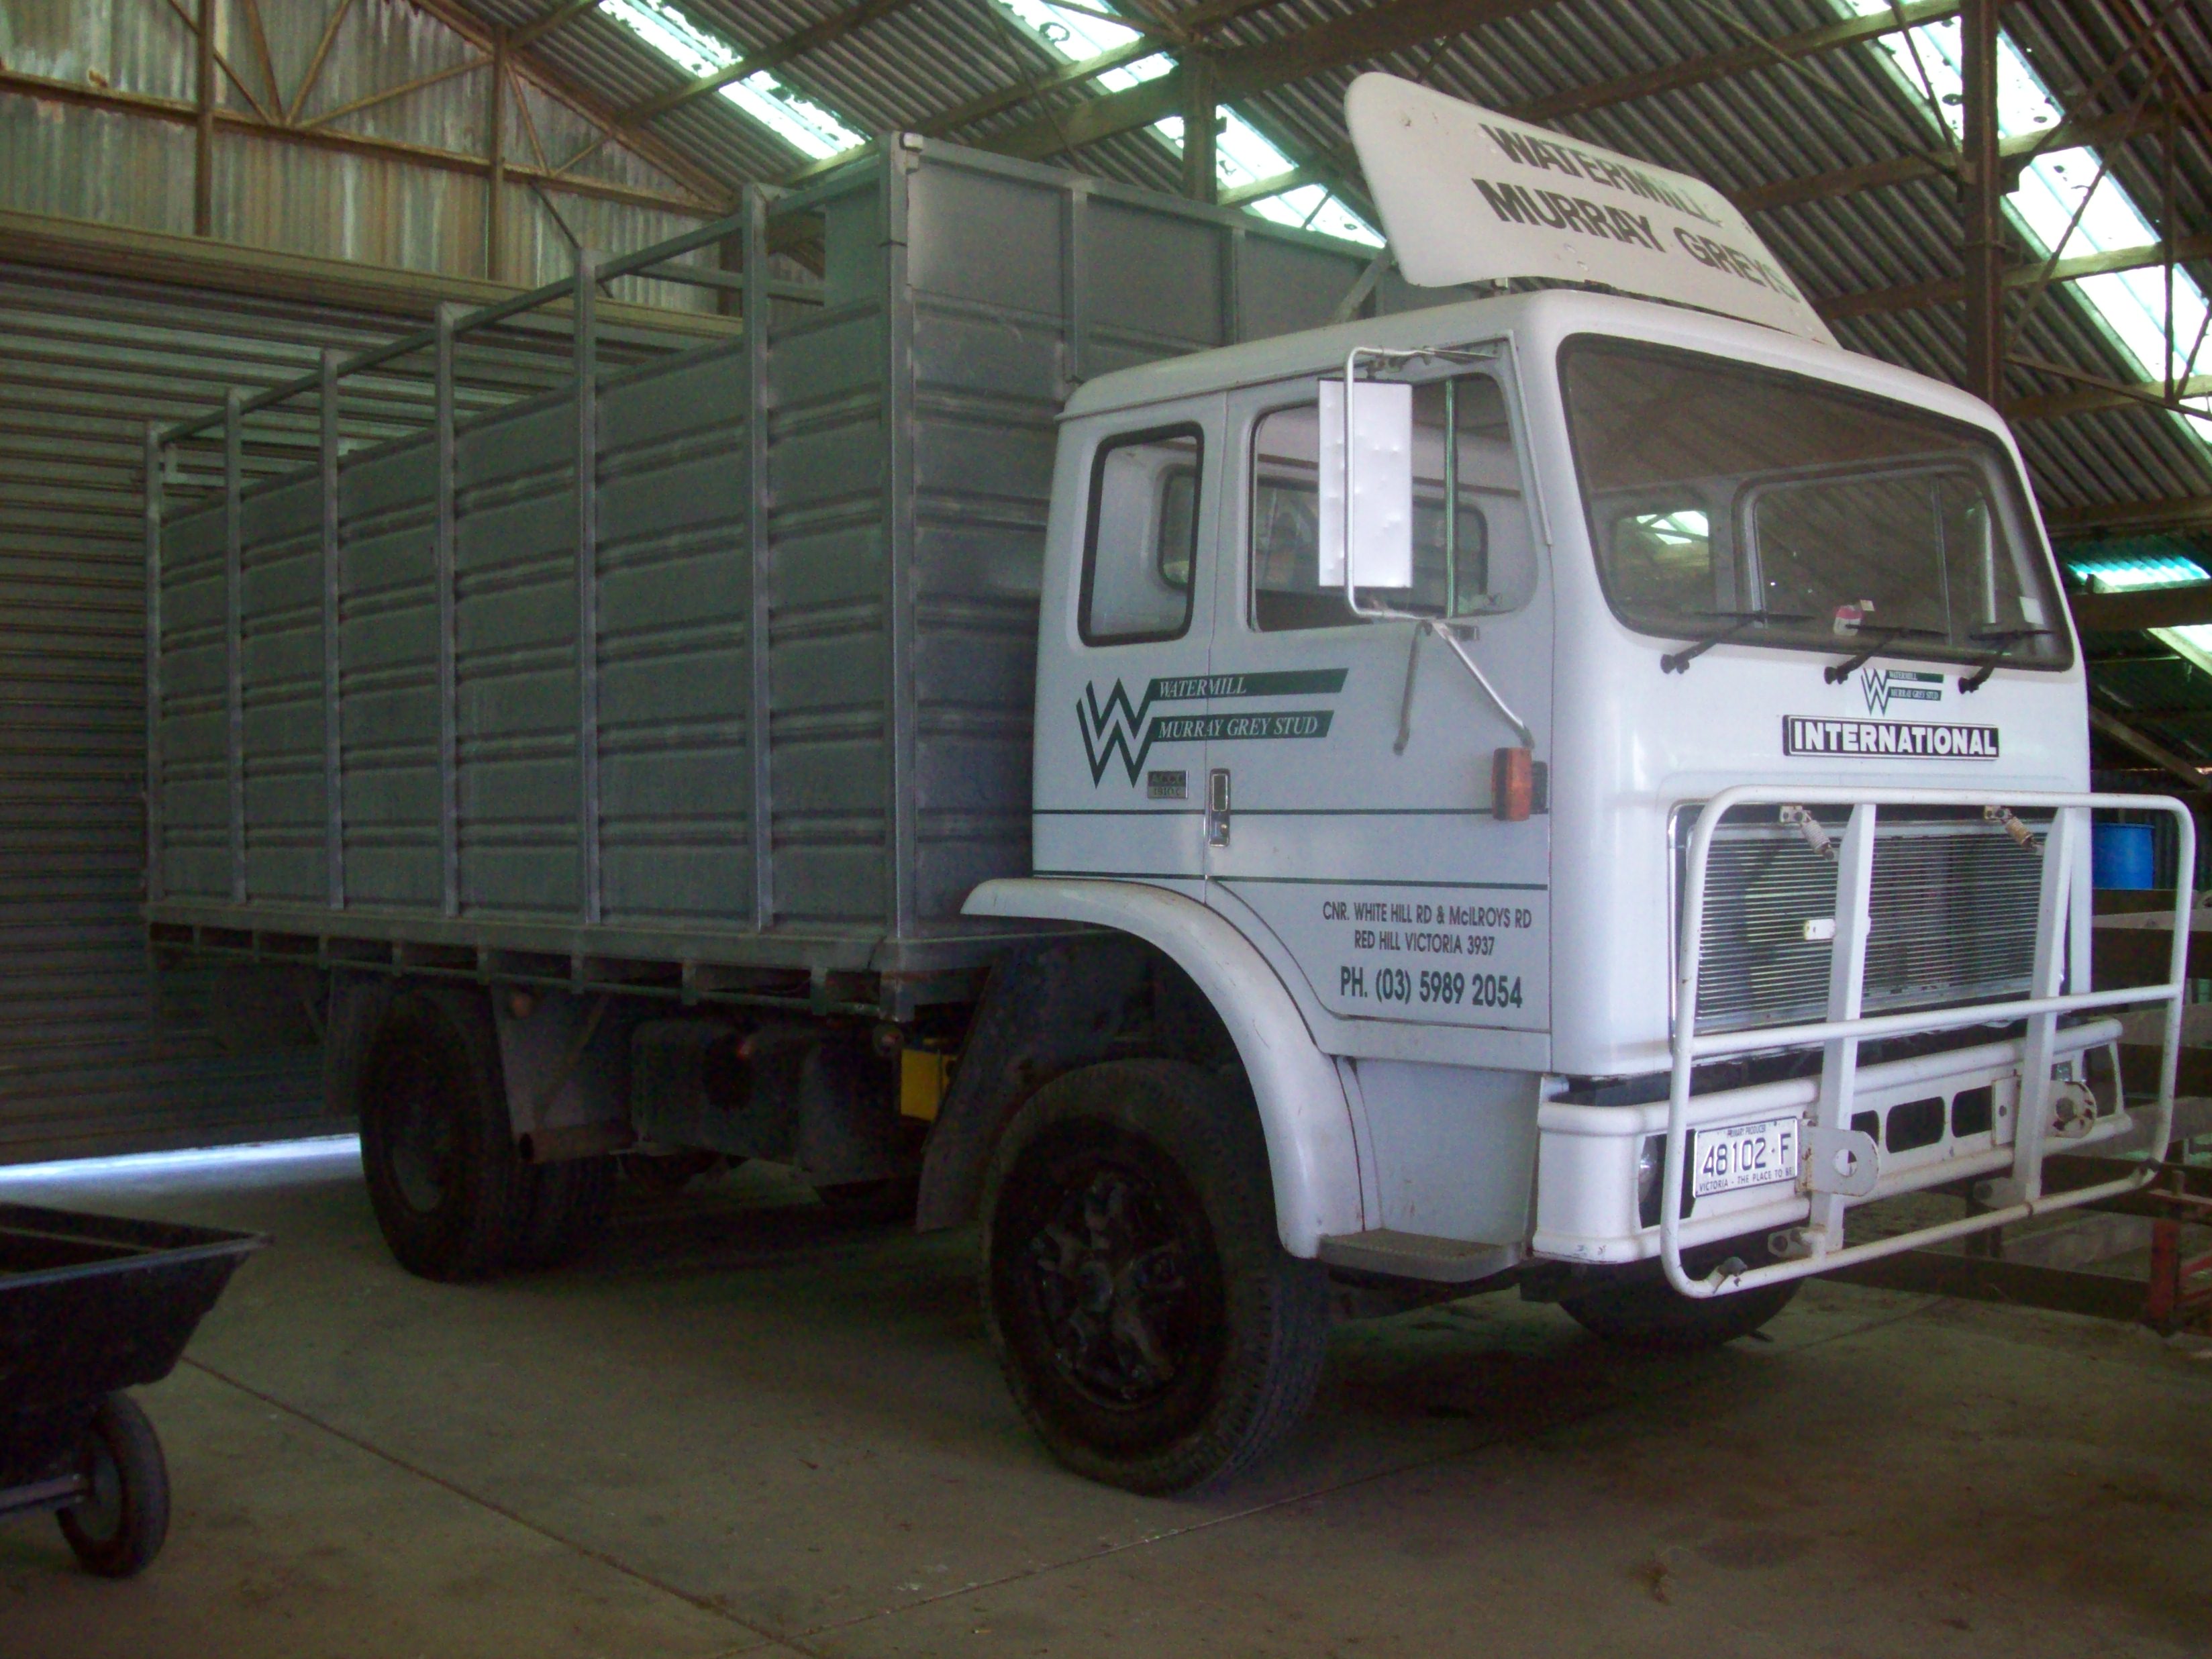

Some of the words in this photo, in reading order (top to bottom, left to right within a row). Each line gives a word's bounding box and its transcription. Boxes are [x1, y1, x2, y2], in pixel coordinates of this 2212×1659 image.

[1478, 123, 1723, 228] WATERMILL
[1472, 179, 1667, 252] MURRAY
[1159, 677, 1247, 698] WATERMILL
[1158, 718, 1224, 738] MURRAY
[1227, 717, 1272, 737] GREY
[1274, 716, 1318, 736] STUD
[1793, 720, 1997, 756] INTERNATIONAL
[1323, 901, 1350, 921] CNR.
[1354, 902, 1387, 922] WHITE
[1391, 904, 1413, 923] HILL
[1416, 905, 1432, 924] RD
[1436, 906, 1445, 924] &
[1449, 906, 1511, 928] McILROYS
[1515, 908, 1532, 929] RD
[1354, 929, 1375, 950] RED
[1379, 931, 1401, 951] HILL
[1405, 932, 1463, 954] VICTORIA
[1467, 936, 1495, 956] 3937
[1340, 966, 1368, 998] PH.
[1376, 968, 1411, 1005] (03)
[1419, 970, 1465, 1005] 5989
[1472, 974, 1523, 1008] 2054
[1699, 1179, 1729, 1193] VICTORIA
[1738, 1174, 1750, 1185] THE
[1752, 1171, 1772, 1182] PLACE
[1774, 1169, 1783, 1179] TO
[1785, 1166, 1793, 1176] BE
